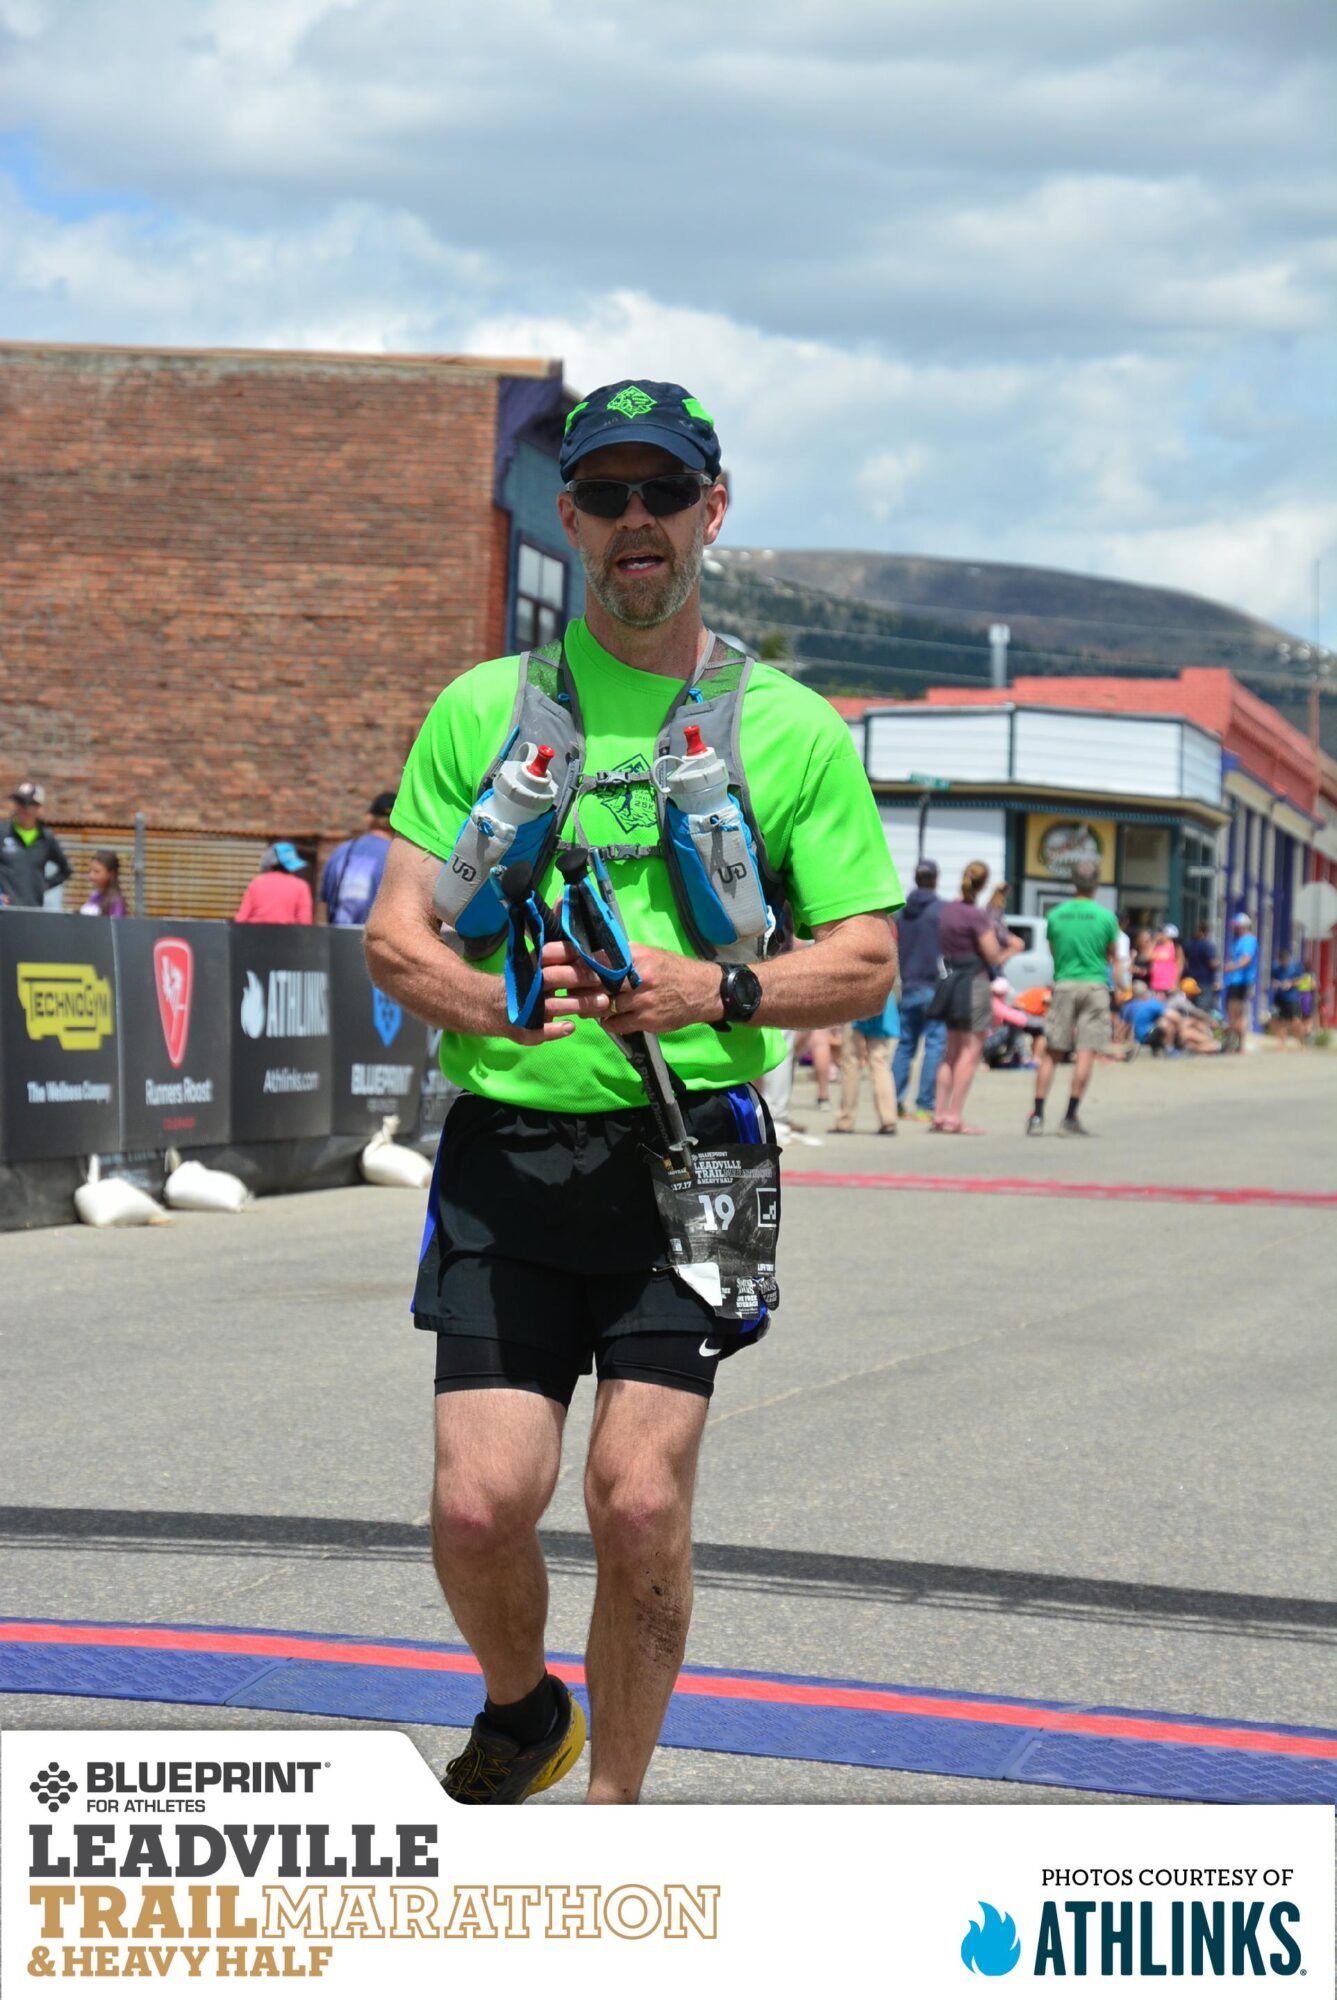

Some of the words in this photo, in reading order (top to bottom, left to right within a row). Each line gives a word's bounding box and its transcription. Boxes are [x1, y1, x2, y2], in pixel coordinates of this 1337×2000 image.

[266, 970, 330, 1038] ATHLINKS
[27, 1080, 46, 1103] The
[145, 1078, 183, 1105] Runners
[183, 1076, 213, 1103] Roost
[693, 1160, 742, 1170] LEADVILLE
[695, 1170, 724, 1179] TRAIL
[698, 1194, 736, 1231] 19
